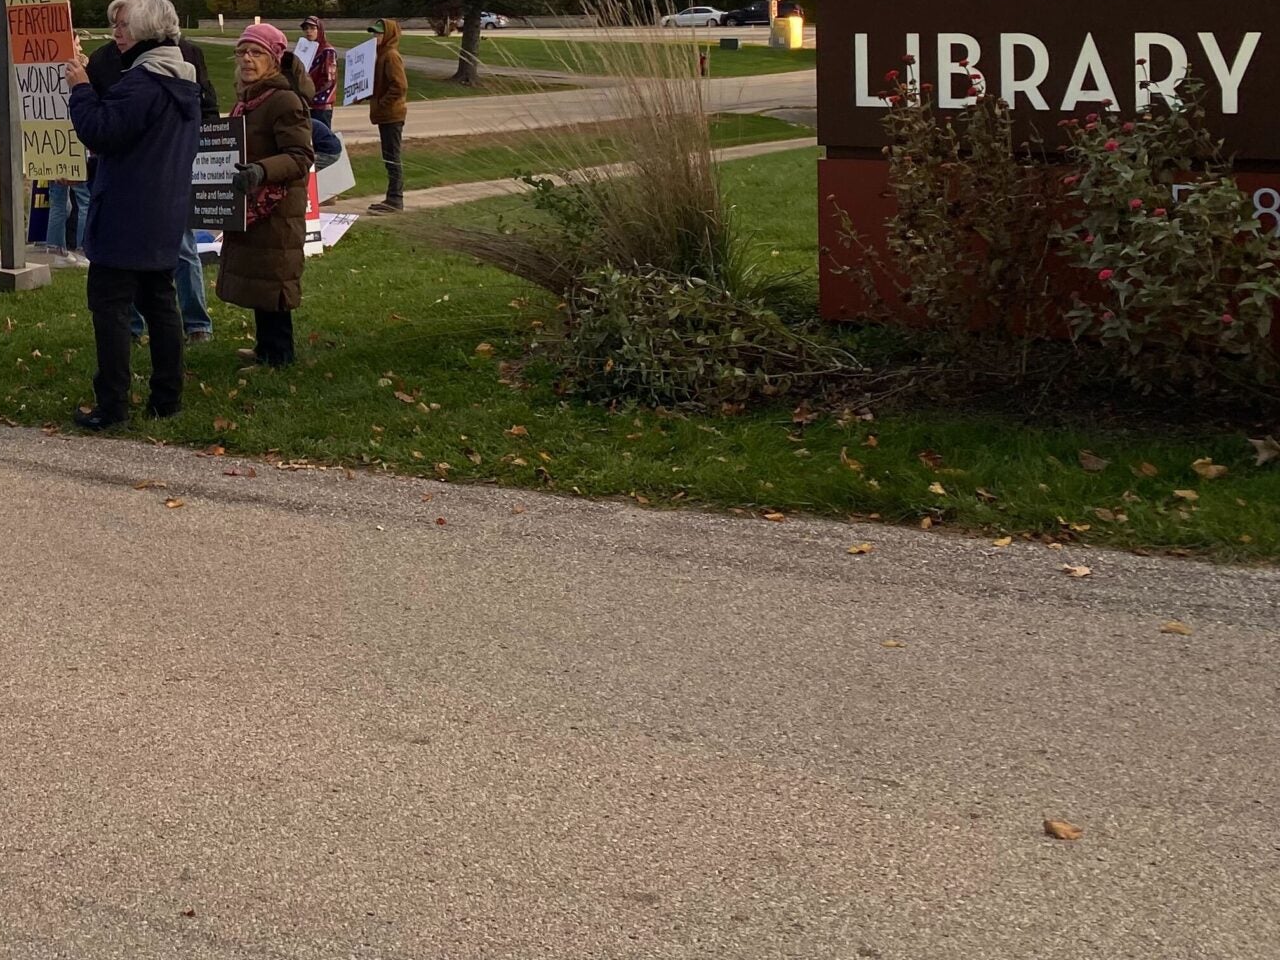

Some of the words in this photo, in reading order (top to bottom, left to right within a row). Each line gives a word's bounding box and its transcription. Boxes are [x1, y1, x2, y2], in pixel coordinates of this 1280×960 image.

[8, 6, 71, 36] FEARFULLY
[23, 38, 59, 62] AND
[16, 64, 71, 94] WONDE
[855, 31, 1262, 115] LIBRARY
[22, 94, 70, 120] FULLY
[204, 123, 212, 132] God
[213, 121, 230, 131] created
[24, 129, 81, 157] MADE
[201, 155, 209, 164] the
[210, 155, 224, 166] image
[225, 153, 231, 163] of
[28, 162, 53, 177] Psalm
[56, 163, 80, 177] 139:14
[200, 171, 206, 179] he
[207, 170, 225, 179] created
[195, 190, 207, 199] male
[208, 190, 216, 199] and
[217, 190, 234, 200] female
[194, 205, 200, 214] he
[201, 205, 218, 215] created
